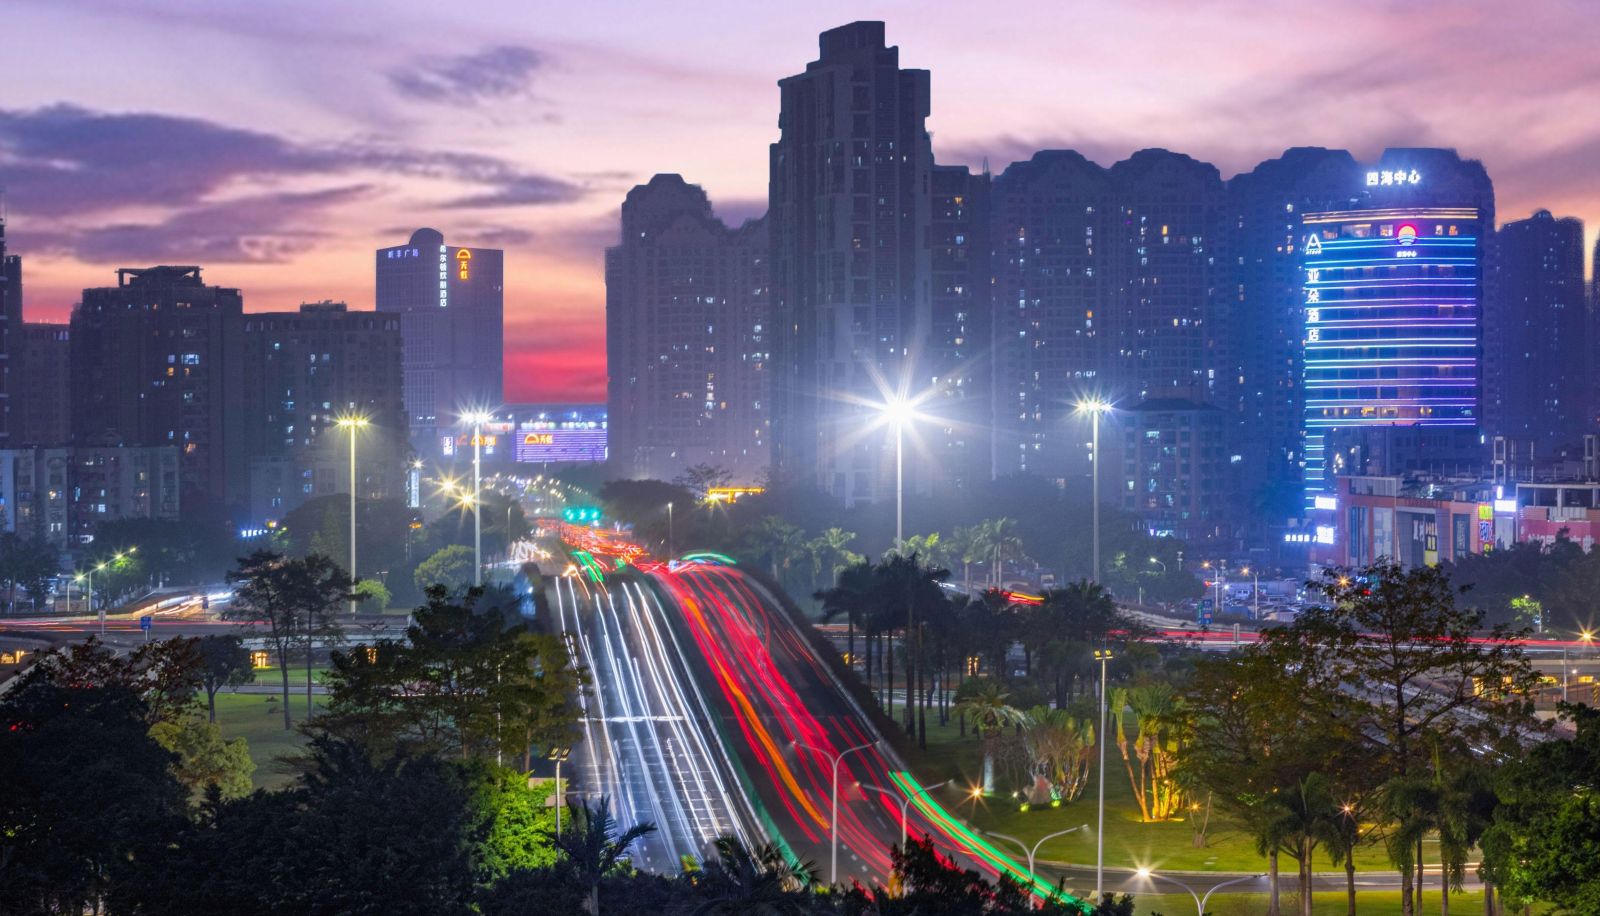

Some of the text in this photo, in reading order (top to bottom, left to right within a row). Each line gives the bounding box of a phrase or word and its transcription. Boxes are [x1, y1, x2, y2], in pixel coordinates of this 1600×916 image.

[1366, 169, 1421, 186] 四海中心
[460, 261, 468, 279] 天虹
[1308, 268, 1320, 341] 亚朵酒店
[539, 434, 553, 445] 天虹
